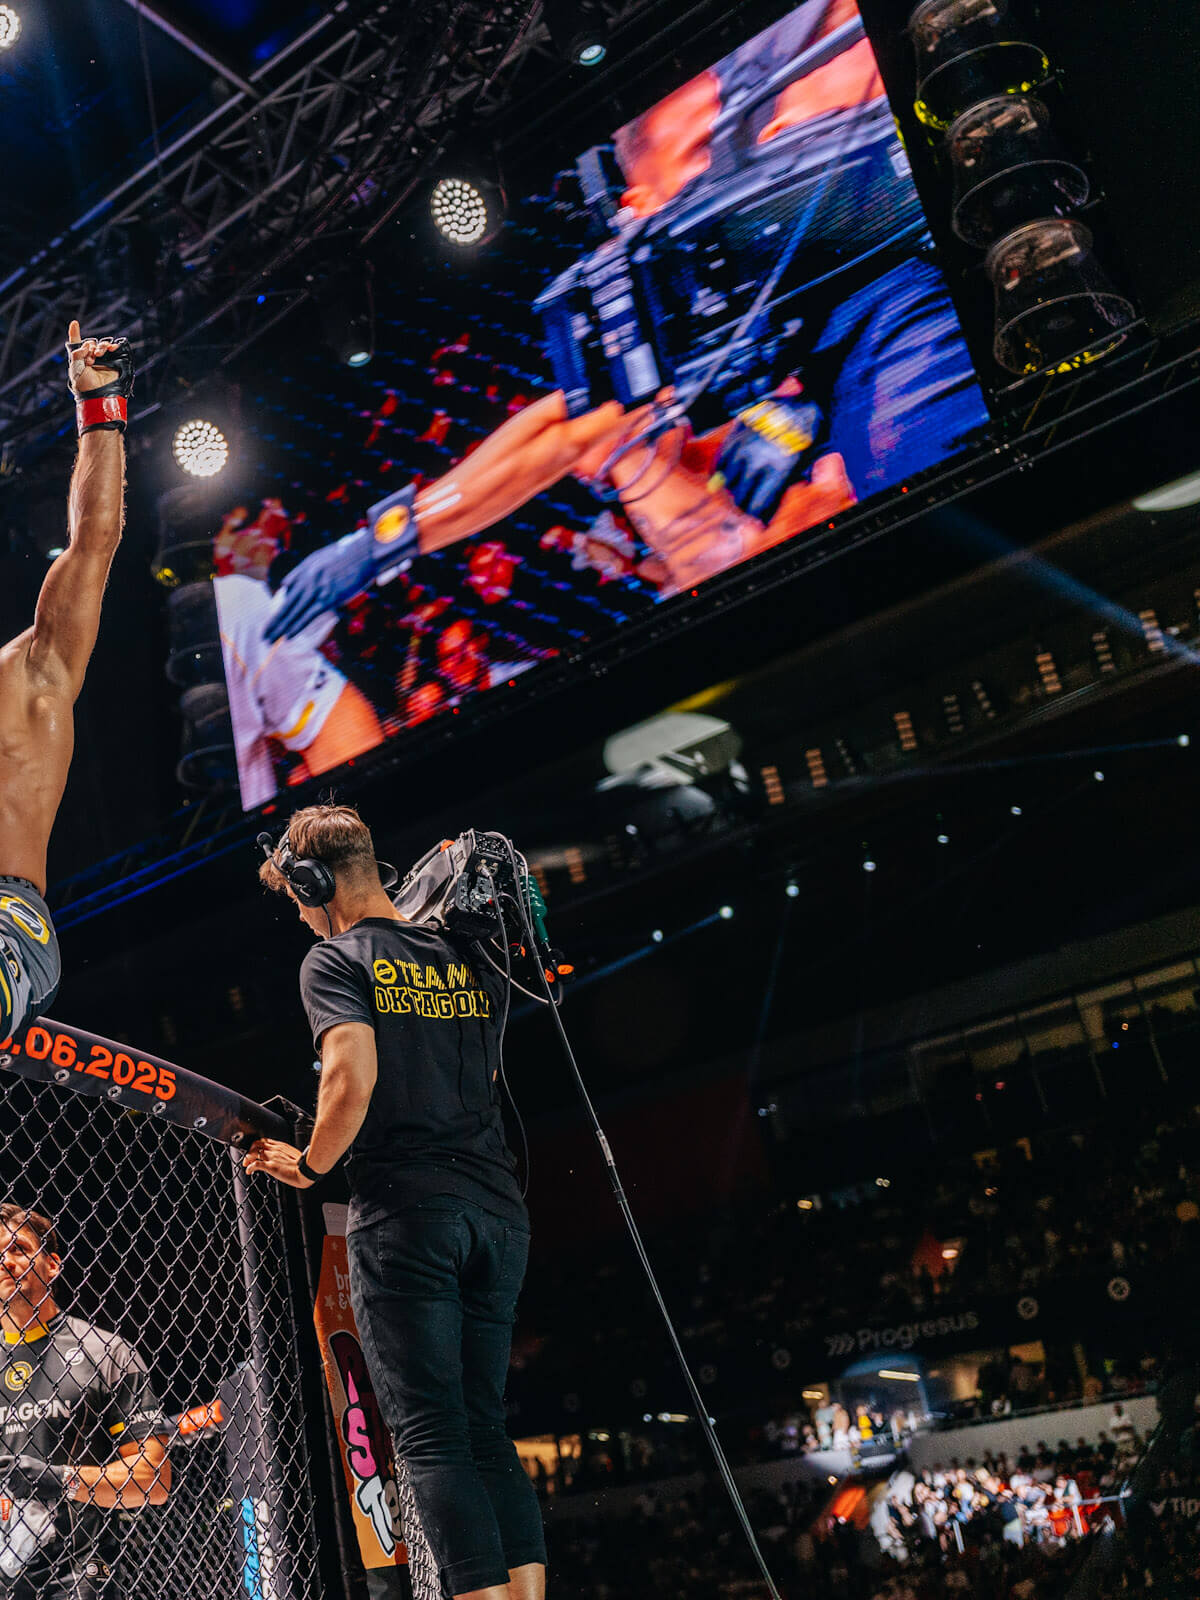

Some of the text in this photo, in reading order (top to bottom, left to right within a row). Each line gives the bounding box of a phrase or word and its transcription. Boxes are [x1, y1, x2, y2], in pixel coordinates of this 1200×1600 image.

[375, 986, 490, 1019] OKTAGON
[857, 1310, 980, 1349] Progresus
[1169, 1496, 1200, 1519] Tip
